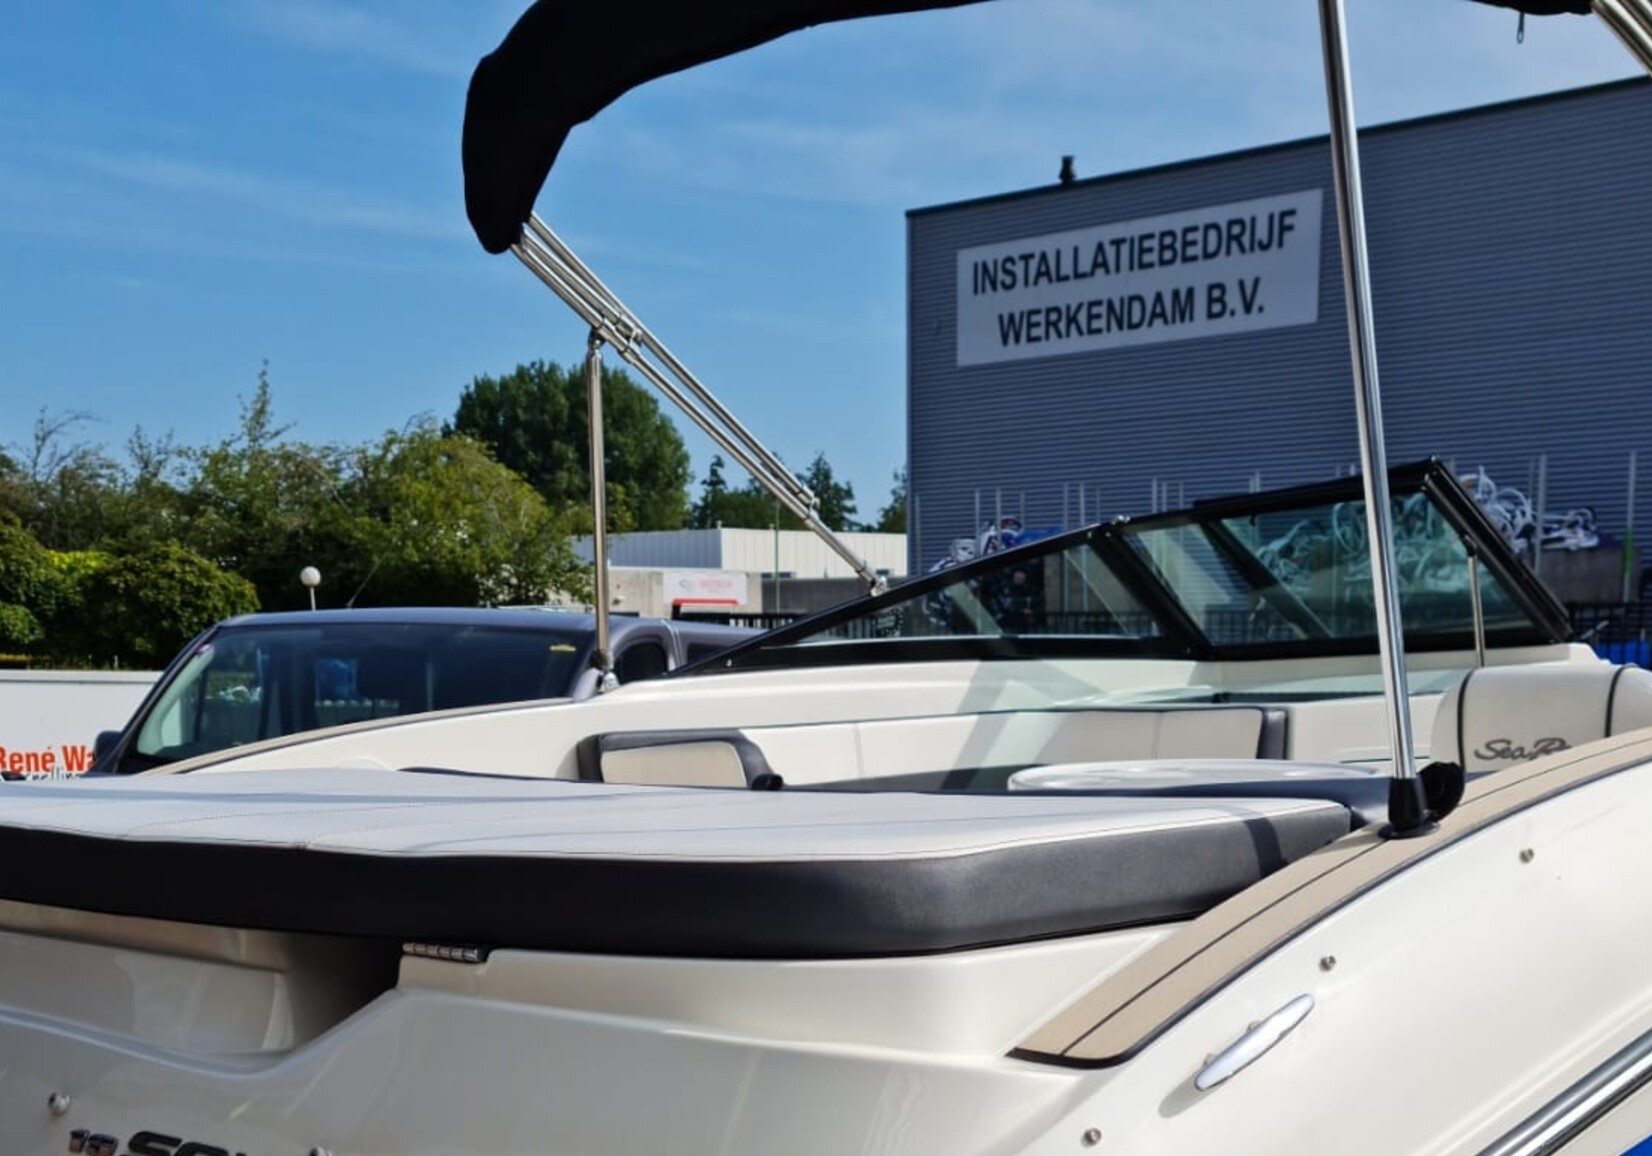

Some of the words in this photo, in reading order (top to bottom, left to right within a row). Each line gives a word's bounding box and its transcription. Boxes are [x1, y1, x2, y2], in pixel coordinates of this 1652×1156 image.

[972, 208, 1297, 296] INSTALLATIEBEDRIJF
[998, 286, 1195, 347] WERKENDAM
[1205, 276, 1265, 320] B.V.
